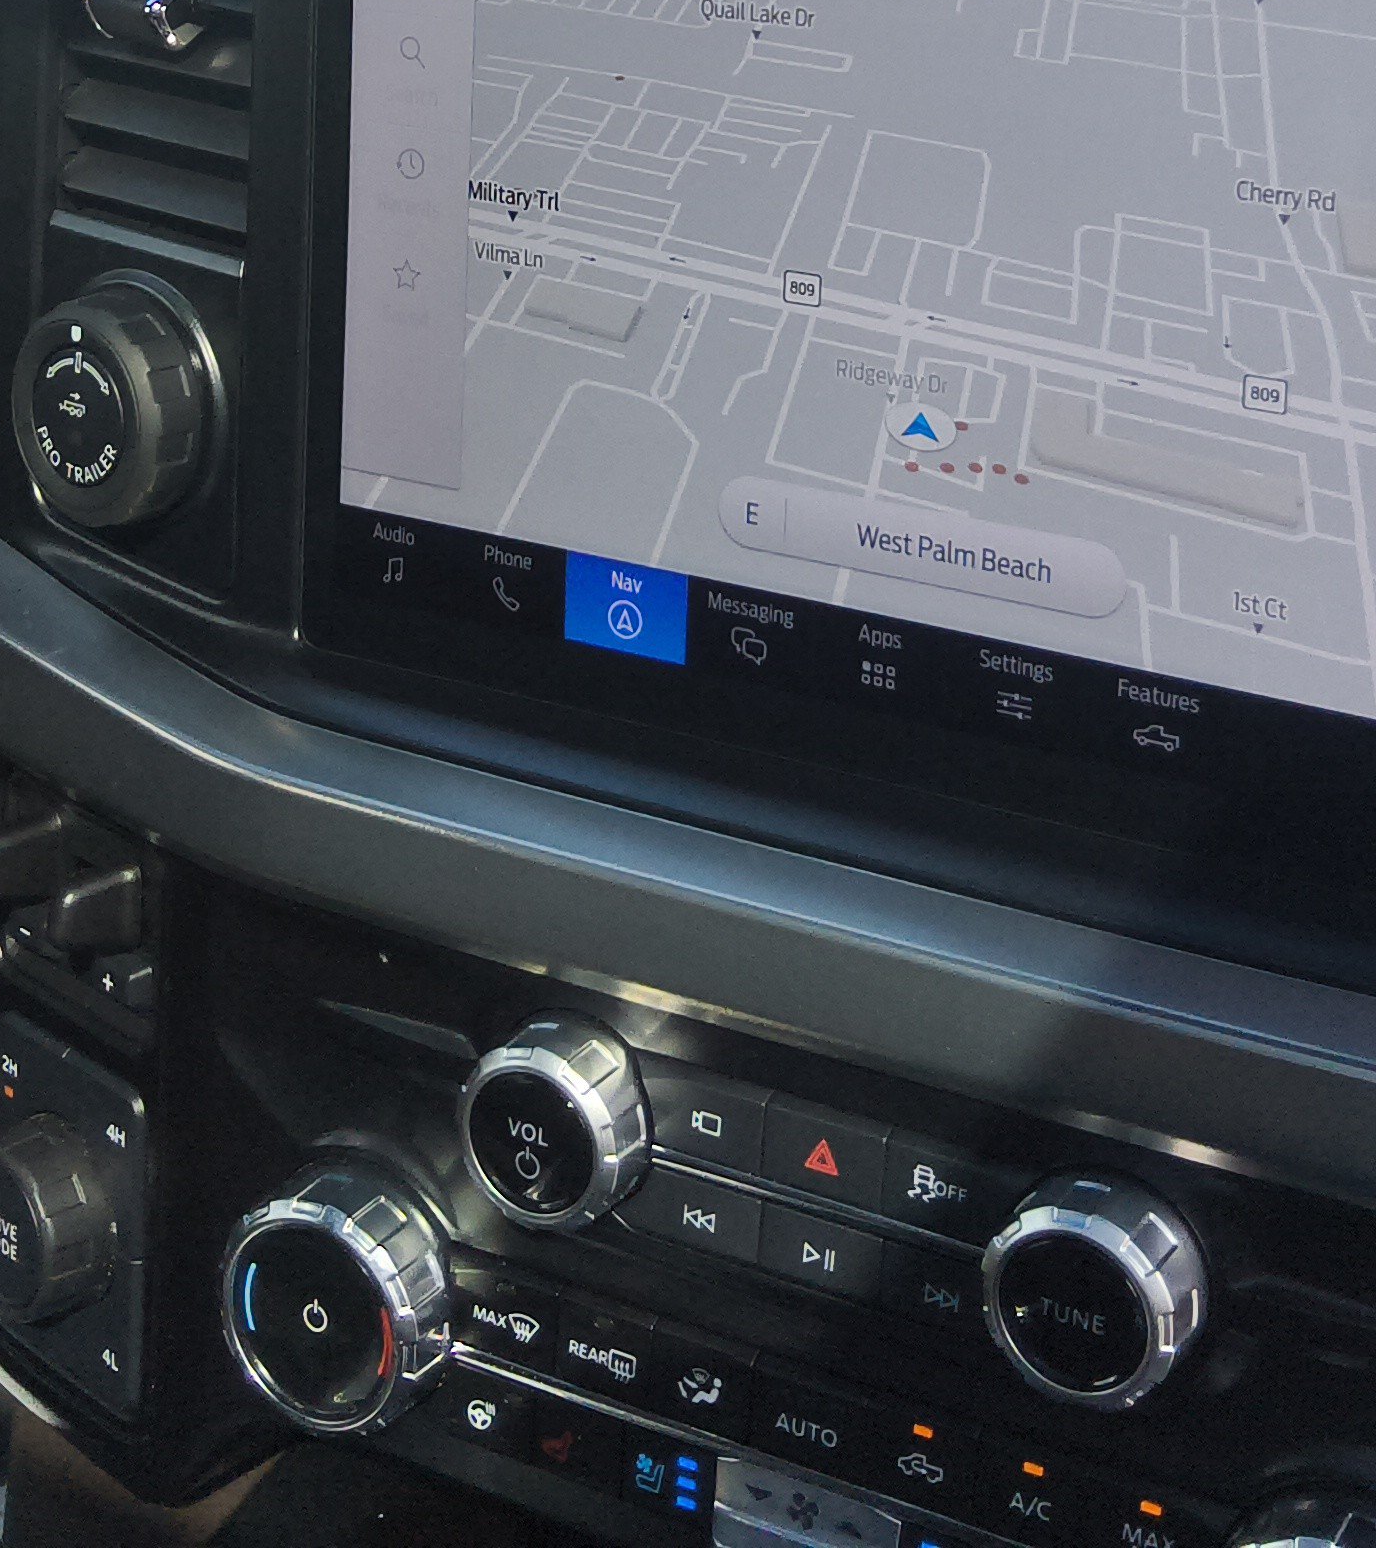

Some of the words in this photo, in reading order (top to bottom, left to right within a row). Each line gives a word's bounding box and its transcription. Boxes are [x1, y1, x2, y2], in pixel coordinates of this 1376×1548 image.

[749, 2, 791, 26] Lake
[794, 7, 815, 28] Dr
[467, 182, 533, 211] Military
[534, 189, 560, 212] Trl
[1235, 180, 1303, 209] Cherry
[1307, 189, 1337, 212] Rd
[474, 241, 518, 265] Vilma
[521, 249, 543, 269] Ln
[789, 279, 816, 299] 809
[836, 359, 924, 392] Ridgeway
[927, 374, 948, 394] Dr
[1249, 385, 1280, 405] 809
[37, 425, 62, 467] PRO
[65, 444, 118, 485] TRAILER
[746, 501, 760, 526] E
[372, 520, 416, 547] Audio
[483, 544, 533, 572] Phone
[857, 523, 913, 556] West
[917, 535, 976, 570] Palm
[980, 546, 1052, 586] Beach
[611, 570, 643, 596] Nav
[707, 592, 795, 629] Messaging
[1232, 591, 1262, 617] 1st
[1265, 597, 1288, 621] Ct
[857, 624, 903, 651] Apps
[978, 649, 1054, 685] Settings
[1117, 679, 1201, 714] Features
[1, 1054, 19, 1078] 2H
[105, 1124, 126, 1148] 4H
[507, 1117, 549, 1148] VOL
[934, 1181, 968, 1203] OFF
[472, 1304, 508, 1330] MAX
[1040, 1296, 1107, 1337] TUNE
[101, 1348, 119, 1372] 4L
[568, 1339, 609, 1366] REAR
[775, 1412, 839, 1449] AUTO
[1009, 1492, 1052, 1522] A/C
